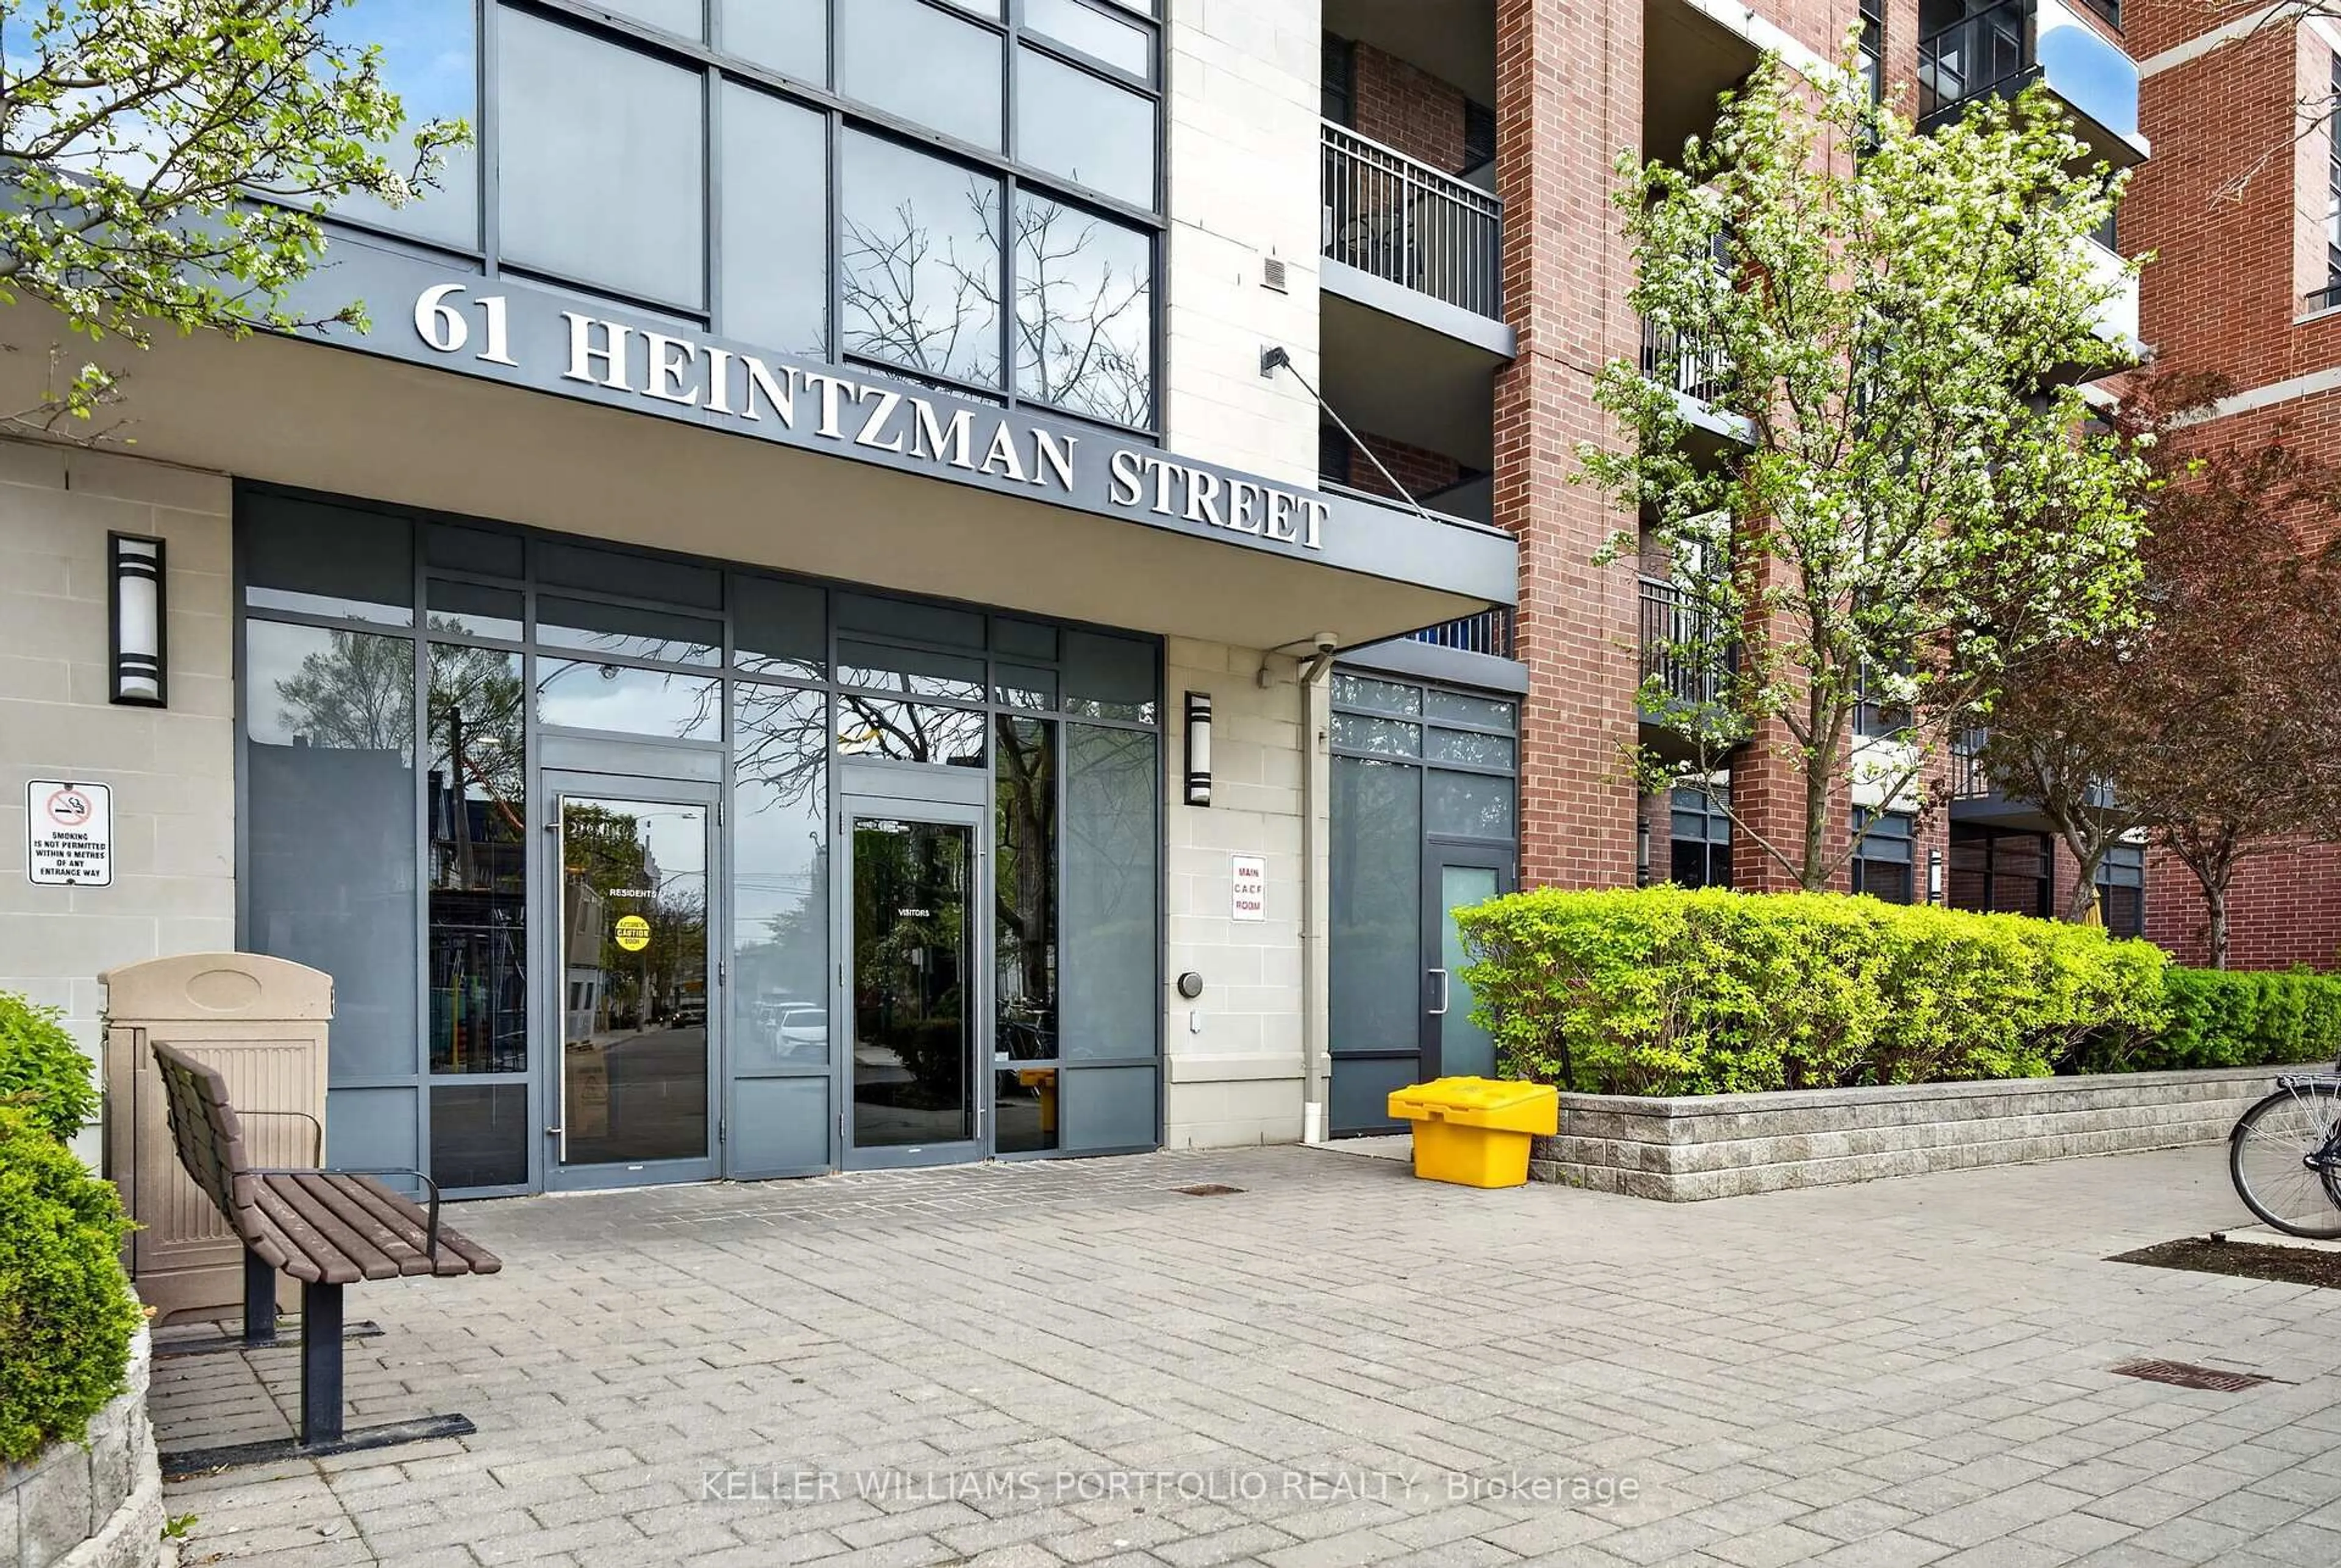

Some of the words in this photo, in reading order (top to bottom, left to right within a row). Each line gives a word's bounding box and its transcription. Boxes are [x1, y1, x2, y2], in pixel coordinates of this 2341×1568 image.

[413, 283, 519, 367] 61
[561, 311, 1078, 491] HEINTZMAN
[1108, 450, 1331, 550] STREET
[35, 849, 64, 858] WITHIN
[1239, 868, 1259, 877] MAIN
[610, 888, 657, 898] RESIDENTS
[1236, 901, 1261, 910] ROOM
[897, 908, 930, 917] VISITORS
